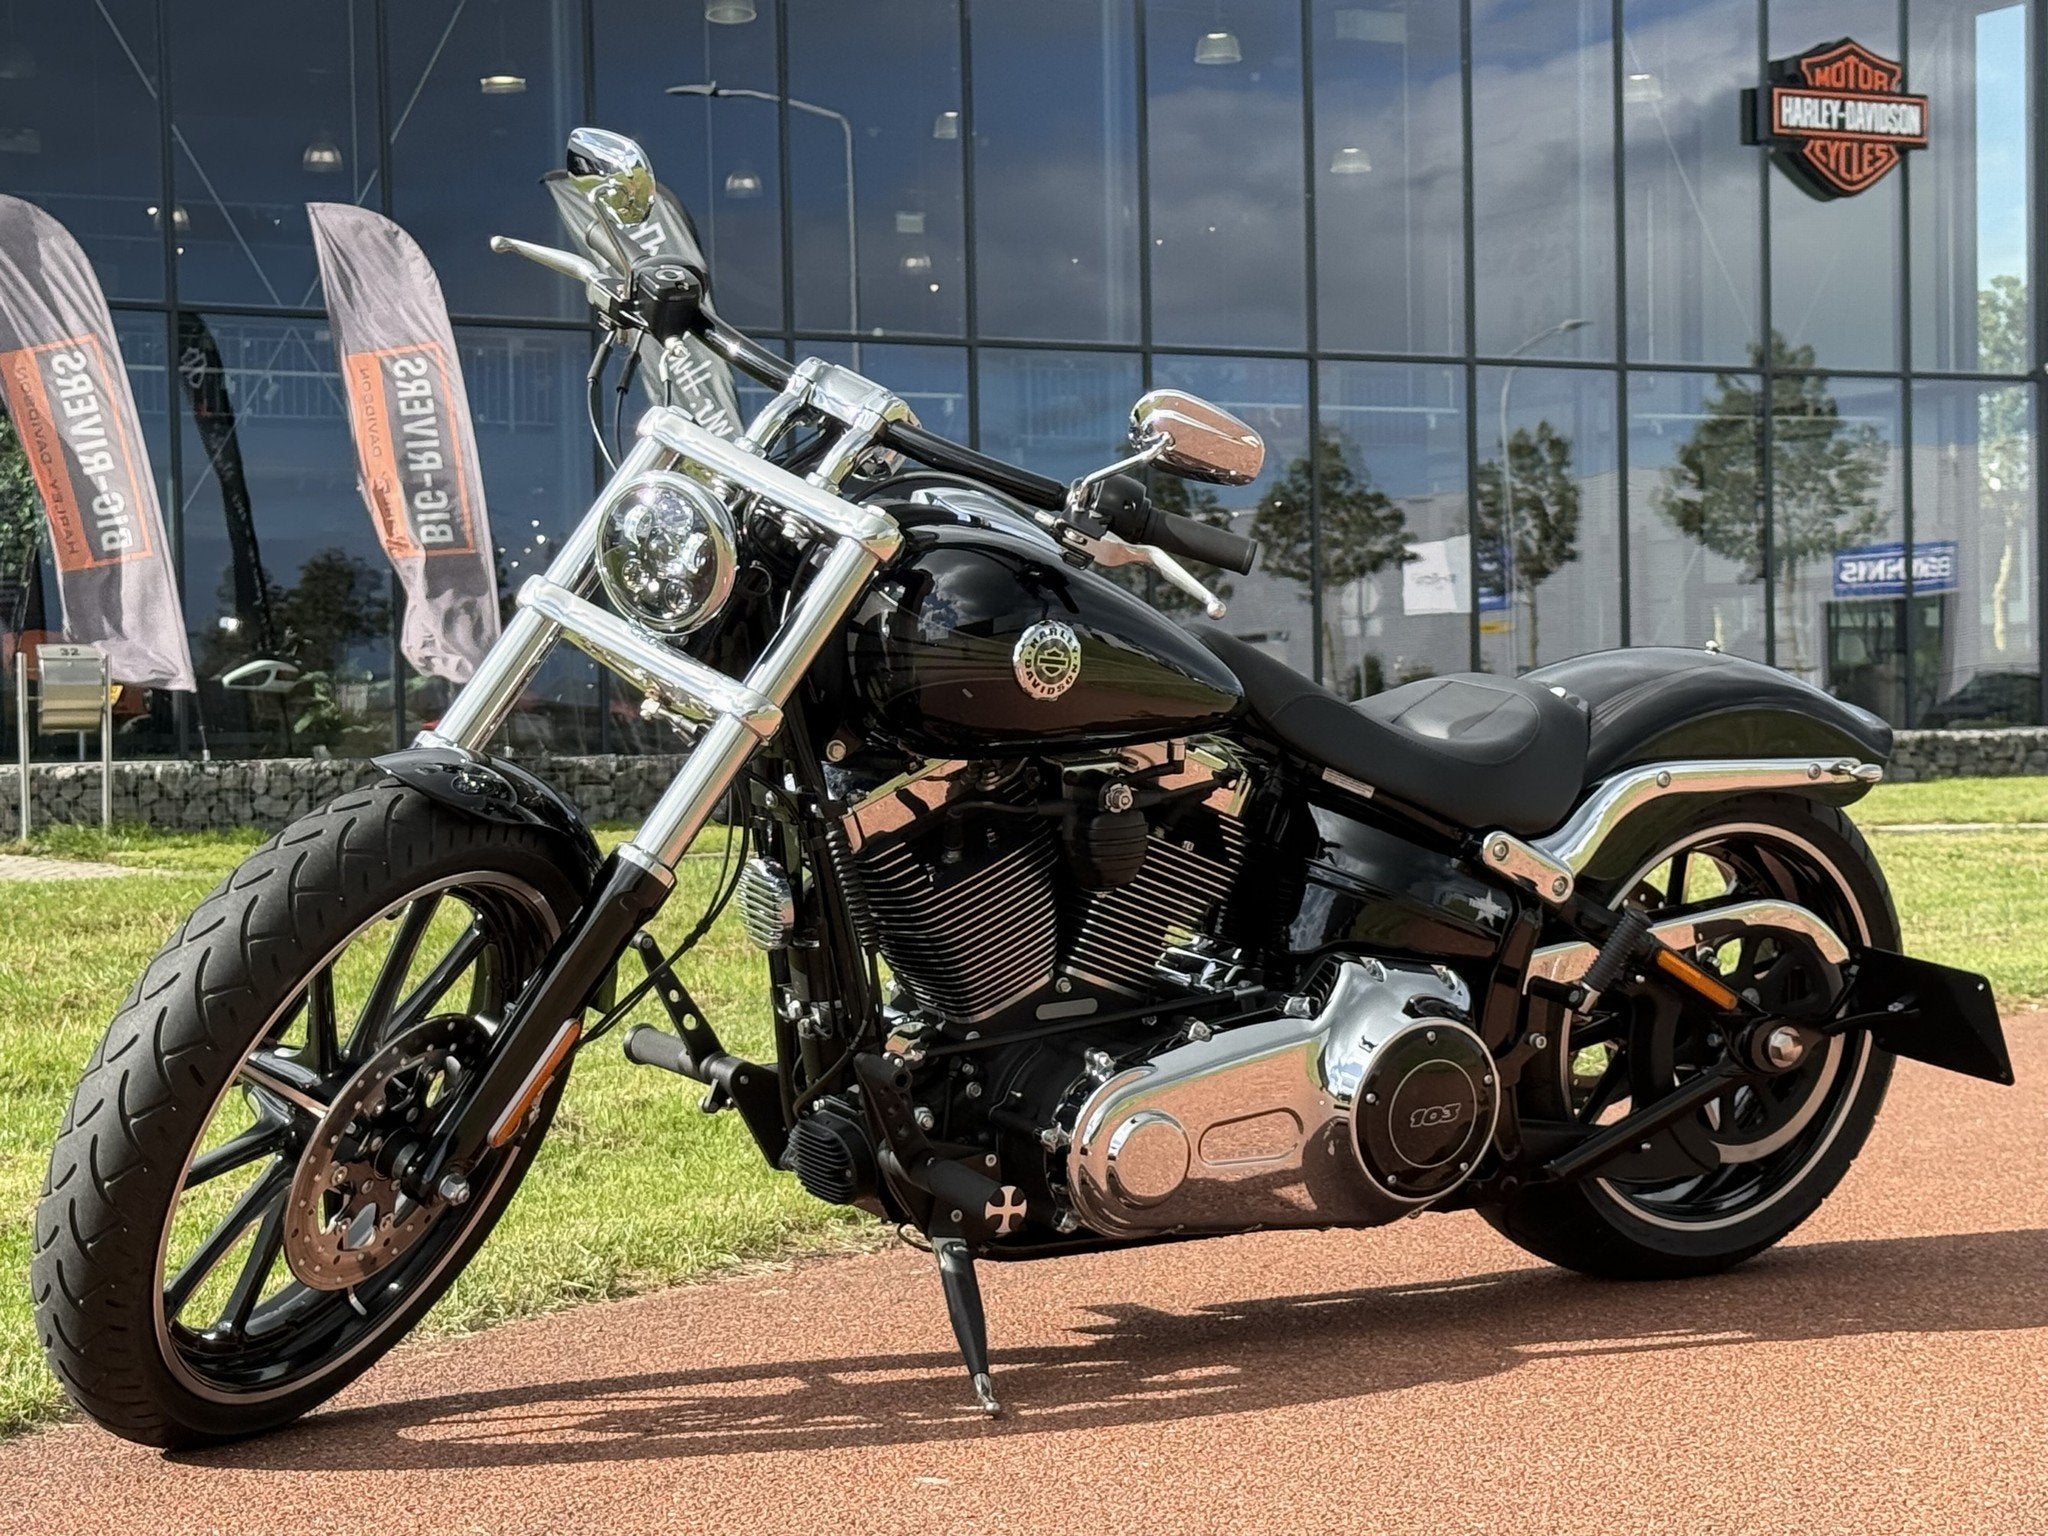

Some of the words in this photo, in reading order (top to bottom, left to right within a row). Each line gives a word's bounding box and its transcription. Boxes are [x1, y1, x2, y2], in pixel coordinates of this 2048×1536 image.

[1814, 55, 1889, 90] MOTOR
[1781, 95, 1921, 136] HARLEY-DAVIDSON
[1814, 141, 1889, 182] CYCLES
[60, 647, 80, 656] 32
[1025, 658, 1078, 695] DAVIDSON
[1410, 1103, 1461, 1128] 103
